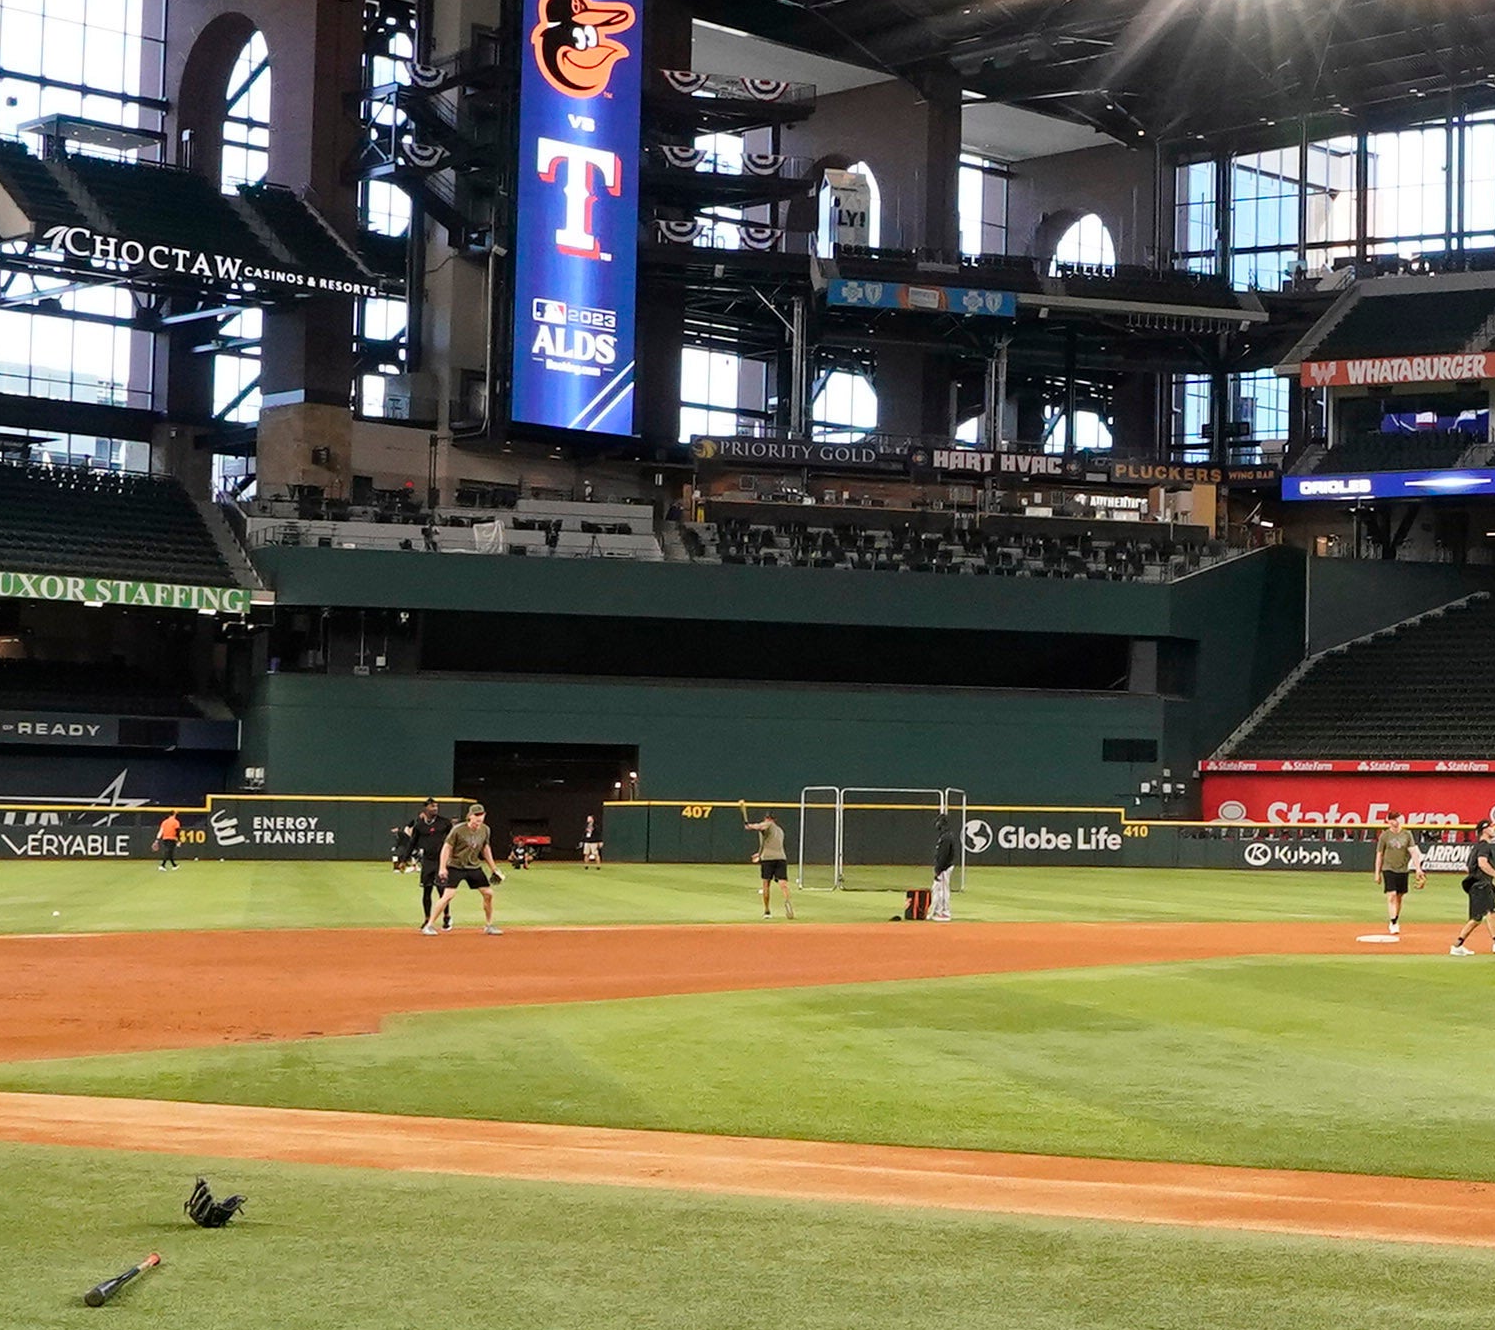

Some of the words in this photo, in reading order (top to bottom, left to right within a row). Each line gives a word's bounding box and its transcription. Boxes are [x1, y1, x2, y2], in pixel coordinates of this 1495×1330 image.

[538, 137, 621, 258] T
[65, 227, 243, 281] CHOCTAW
[244, 267, 303, 285] CASINOS
[308, 277, 316, 287] &
[320, 279, 378, 297] RESORTS
[568, 308, 616, 328] 2023
[532, 324, 617, 365] ALDS
[1346, 354, 1487, 384] WHATABURGER
[720, 440, 815, 460] PRIORITY
[820, 446, 876, 463] GOLD
[933, 449, 995, 472] HART
[1001, 454, 1062, 475] HVAC
[1115, 463, 1222, 483] PLUCKERS
[1299, 479, 1371, 495] ORIOLES
[95, 579, 245, 611] STAFFING
[17, 722, 101, 736] READY
[682, 806, 712, 818] 407
[253, 817, 318, 830] ENERGY
[1123, 825, 1148, 838] 410
[253, 830, 336, 845] TRANSFER
[997, 826, 1071, 852] Globe
[1078, 825, 1122, 852] Life
[1274, 844, 1341, 866] Kubota
[1425, 845, 1473, 861] ARROW
